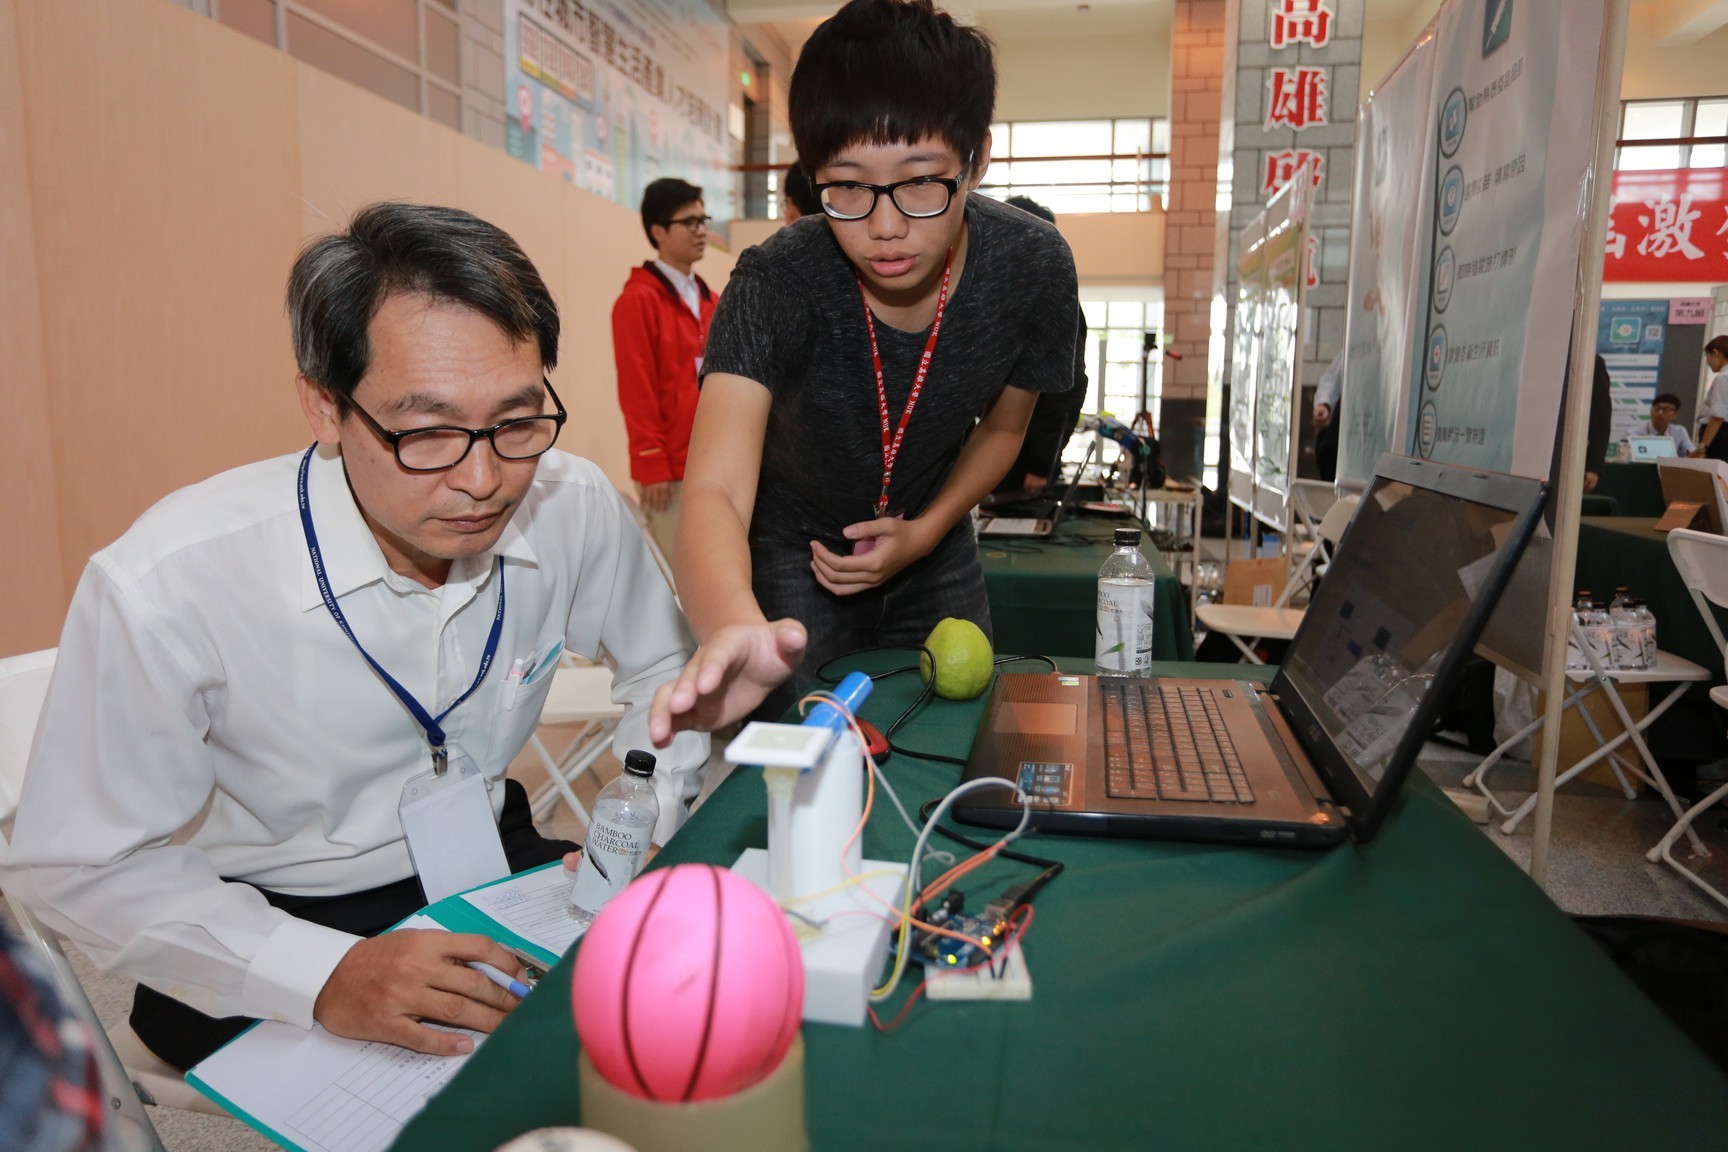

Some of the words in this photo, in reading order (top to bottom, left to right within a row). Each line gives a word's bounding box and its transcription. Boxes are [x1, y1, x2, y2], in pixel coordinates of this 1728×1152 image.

[905, 400, 916, 415] NUK
[310, 546, 321, 577] NATIONAL
[318, 577, 337, 612] UNIVERSITY
[593, 830, 639, 849] CHARCOAL
[596, 822, 632, 840] BAMBOO
[592, 836, 618, 854] WATER
